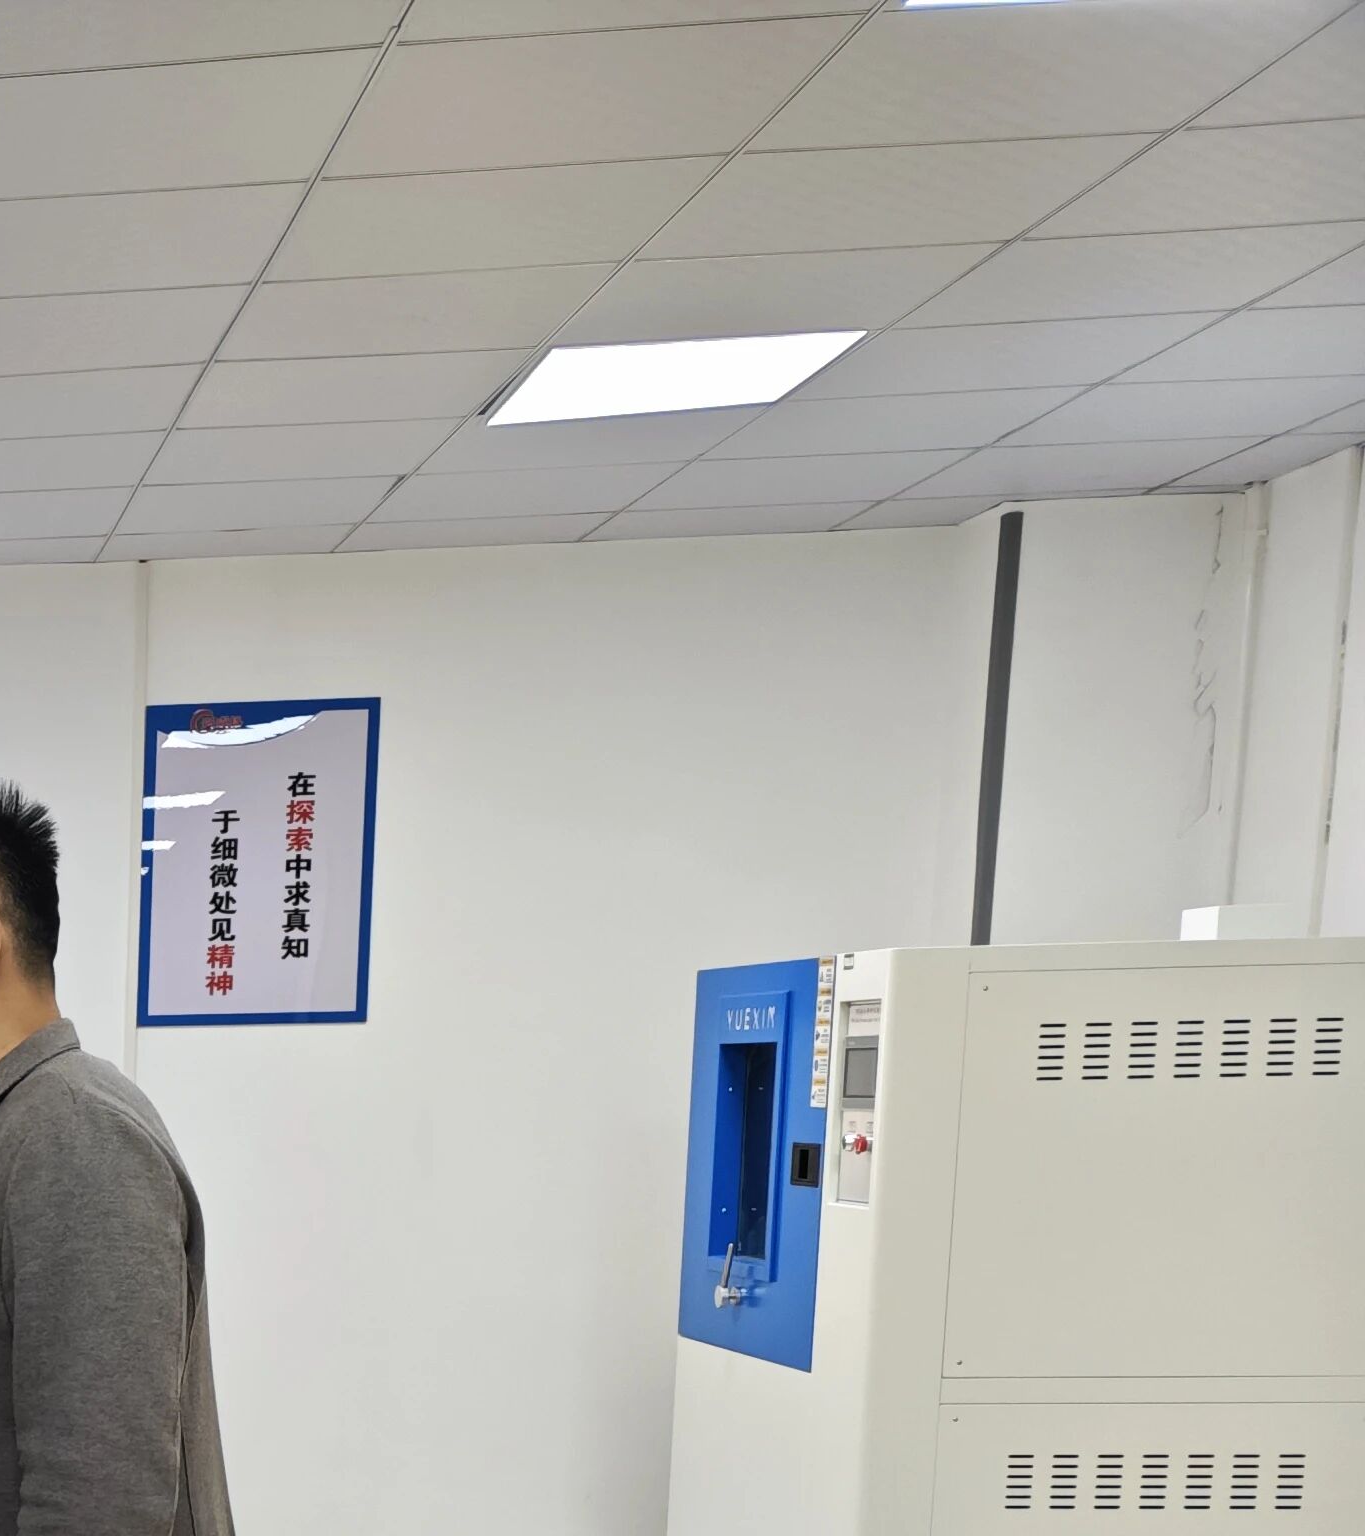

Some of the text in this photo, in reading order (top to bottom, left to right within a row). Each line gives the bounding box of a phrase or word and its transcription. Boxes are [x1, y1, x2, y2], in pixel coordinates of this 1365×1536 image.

[205, 809, 241, 997] 于细微处见精神
[281, 771, 317, 960] 在探索中求真知
[727, 1005, 776, 1031] YUEXIN
